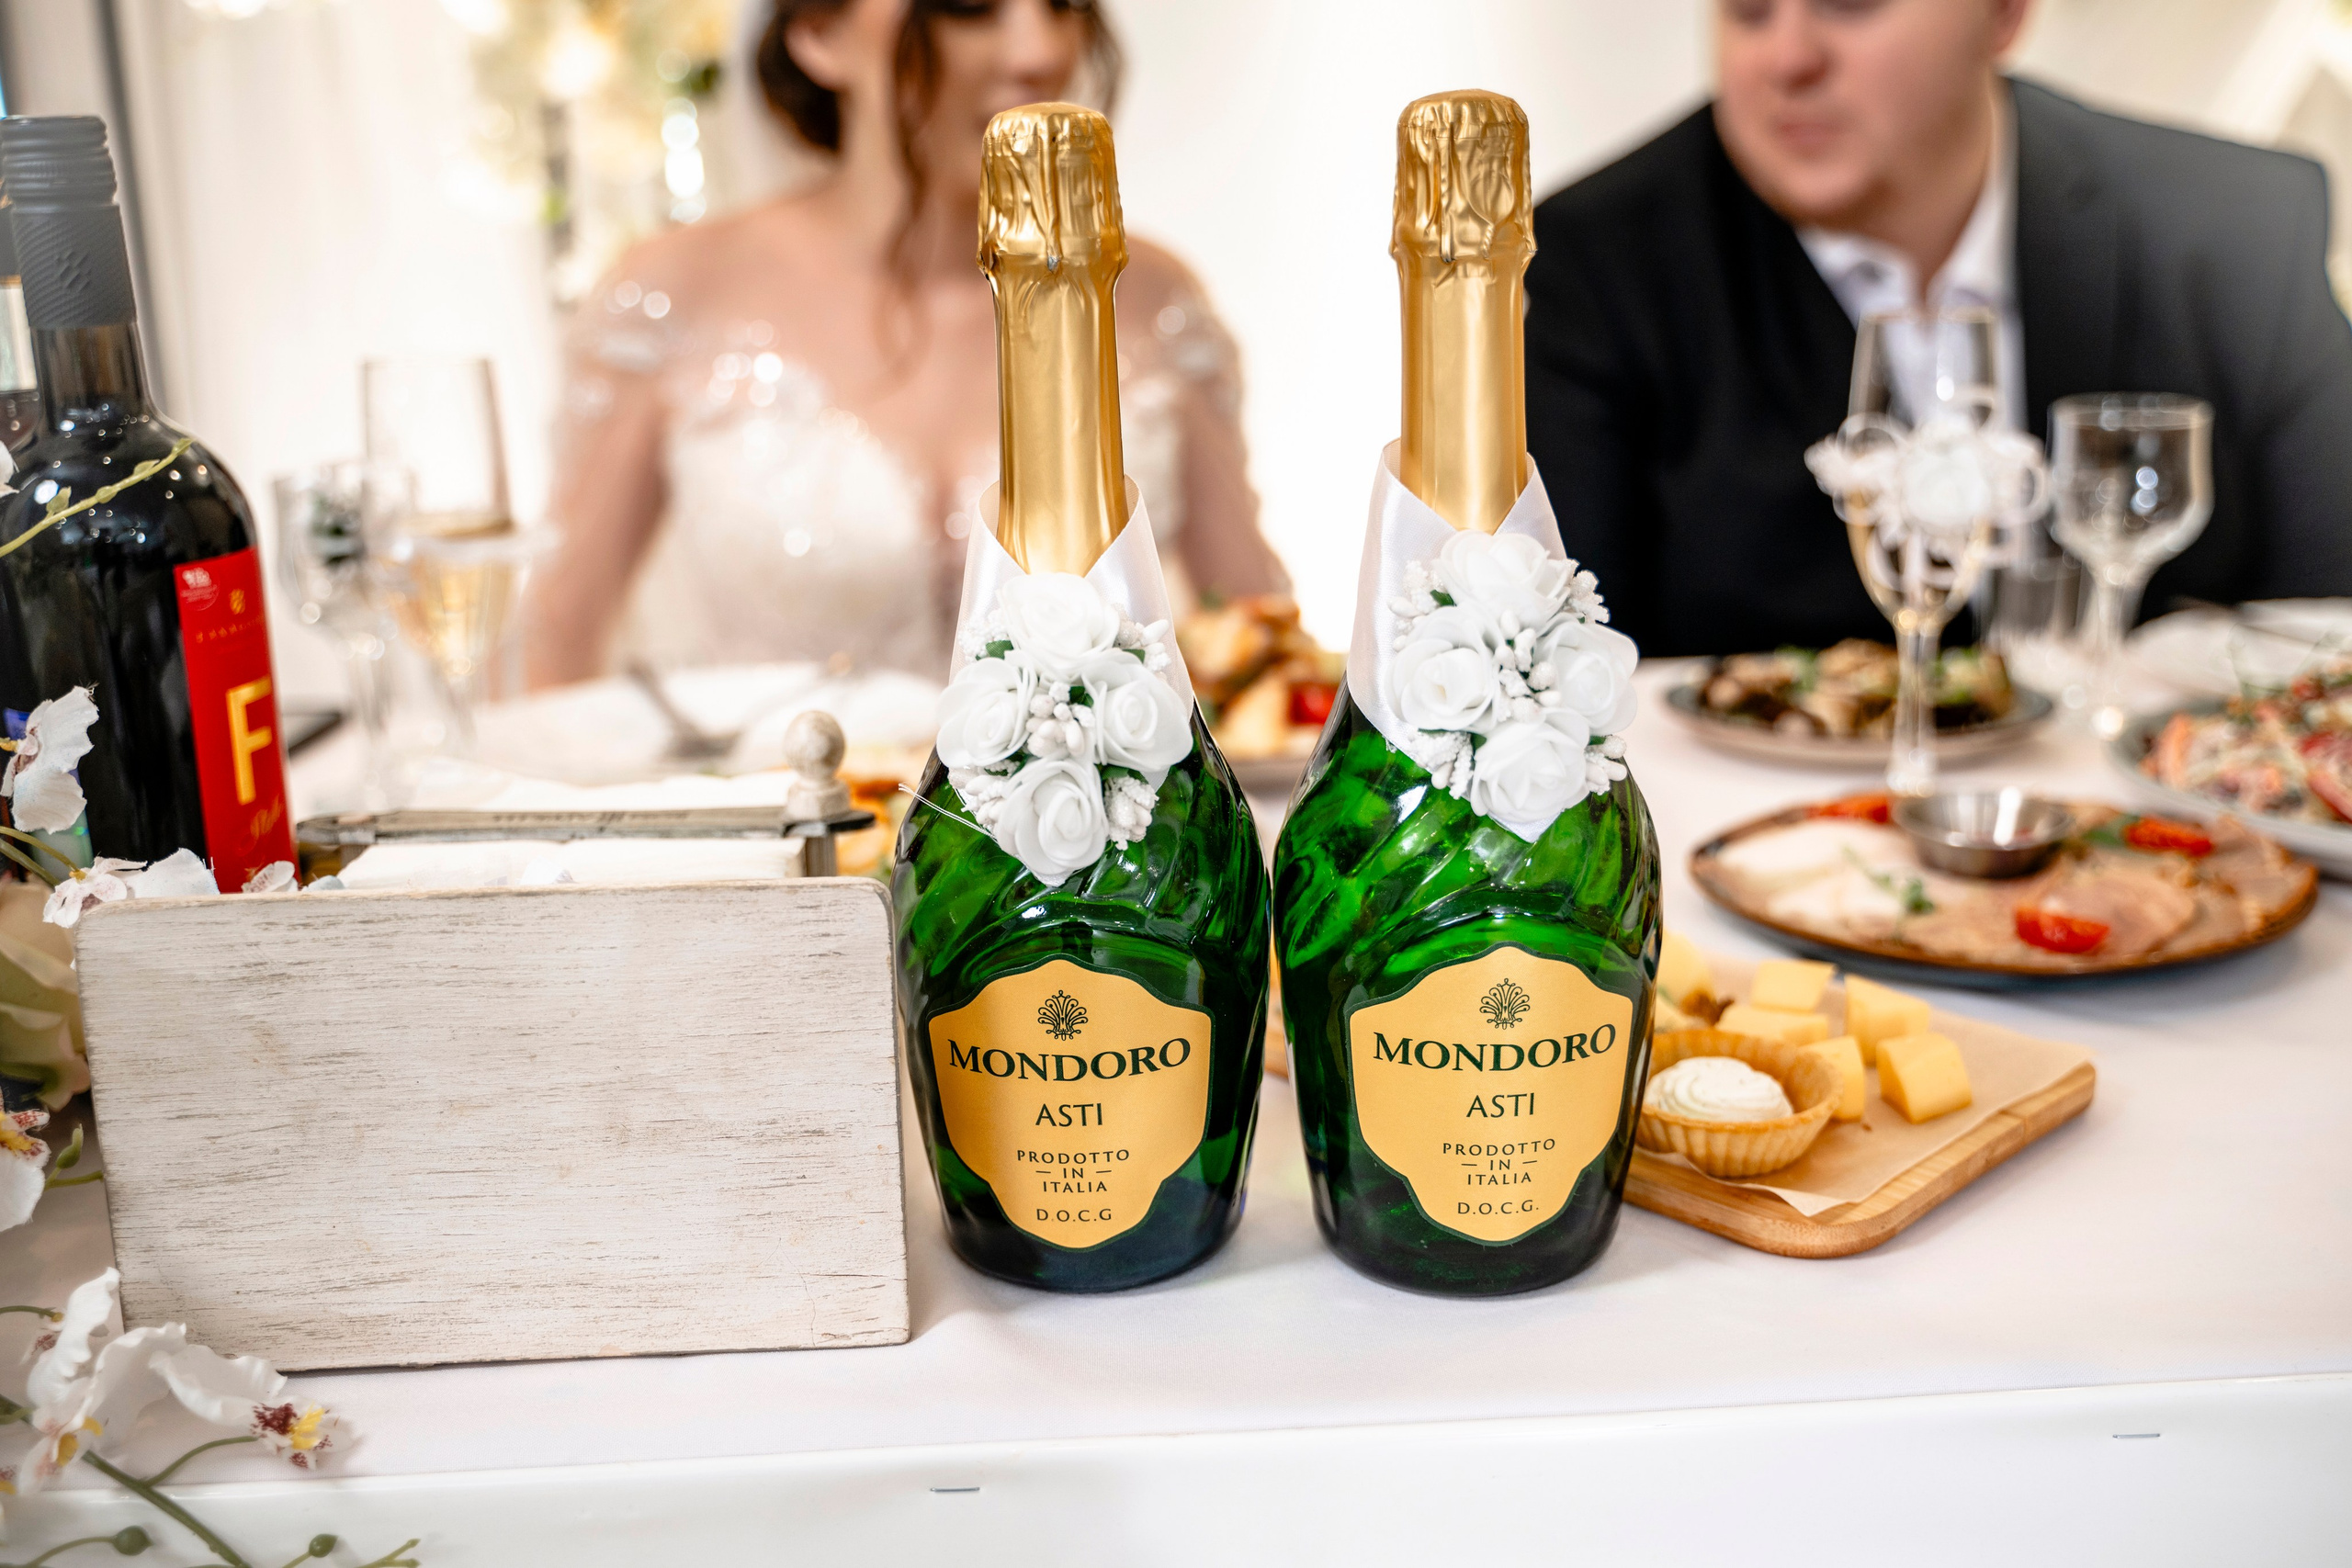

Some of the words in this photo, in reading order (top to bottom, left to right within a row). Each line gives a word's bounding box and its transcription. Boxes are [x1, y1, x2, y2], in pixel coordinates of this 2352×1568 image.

[225, 675, 273, 806] F
[1373, 1023, 1616, 1072] MONDORO
[947, 1037, 1191, 1082] MONDORO
[1465, 1092, 1535, 1119] ASTI
[1035, 1102, 1103, 1127] ASTI
[1442, 1138, 1555, 1156] PRODOTTO
[1016, 1149, 1130, 1165] PRODOTTO
[1489, 1158, 1510, 1171] IN
[1063, 1168, 1084, 1179] IN
[1467, 1171, 1532, 1186] ITALIA
[1043, 1180, 1107, 1193] ITALIA
[1457, 1199, 1539, 1215] D.O.C.G.
[1036, 1208, 1112, 1223] D.O.C.G
